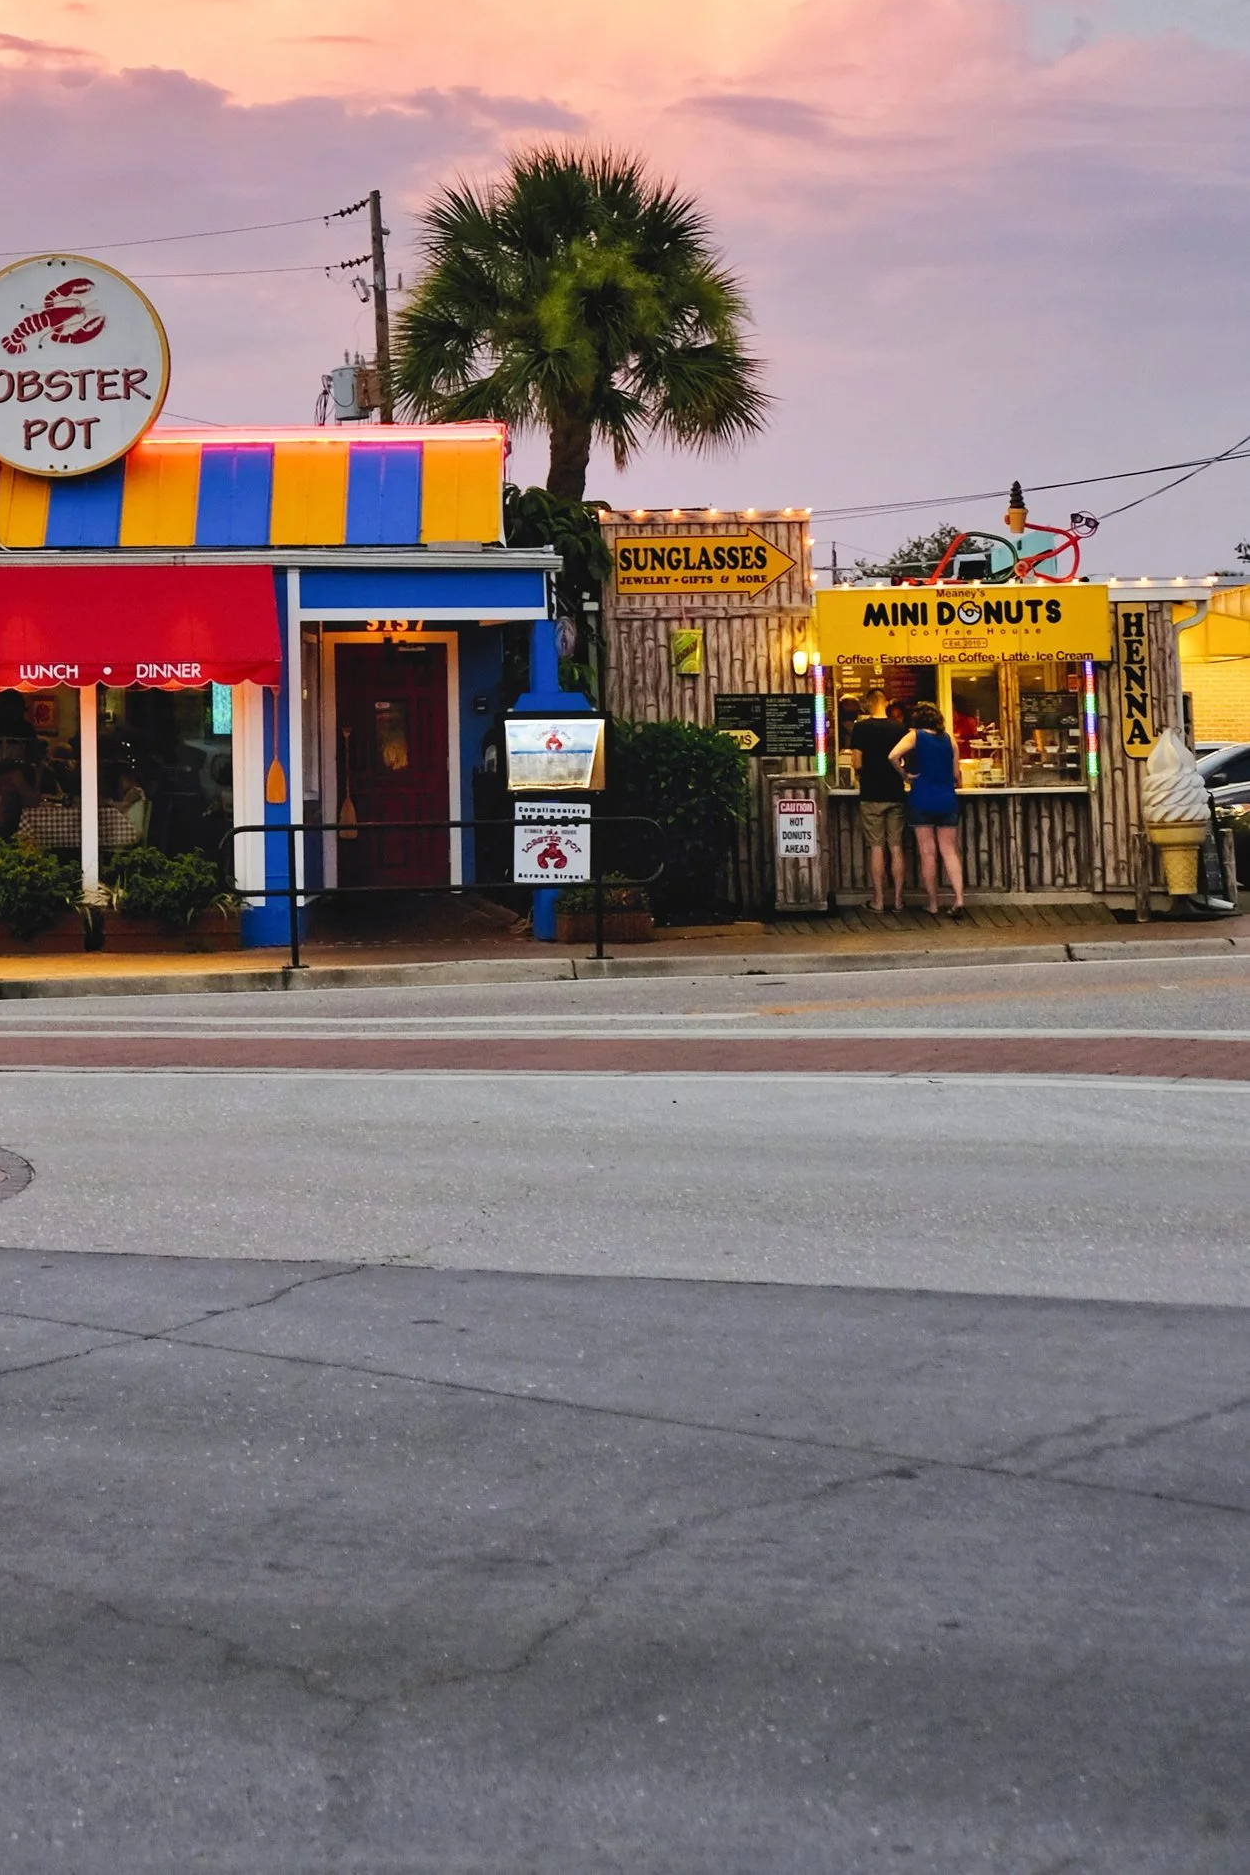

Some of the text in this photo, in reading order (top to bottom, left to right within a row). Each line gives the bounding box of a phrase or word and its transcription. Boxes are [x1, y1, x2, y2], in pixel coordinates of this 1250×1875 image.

[23, 417, 100, 451] POT
[619, 546, 767, 571] SUNGLASSES
[620, 575, 768, 585] JEWELRY GIFTS & MORE
[936, 588, 985, 599] Meaney's
[863, 599, 1062, 627] MINI DONUTS
[910, 628, 972, 636] Coffee
[987, 627, 1041, 635] House
[837, 654, 873, 664] Coffee
[880, 654, 932, 665] Espresso
[939, 653, 955, 663] Ice
[958, 652, 995, 663] Coffee
[1036, 651, 1053, 661] Ice
[1056, 650, 1094, 661] Cream
[20, 664, 79, 679] LUNCH
[136, 663, 202, 679] DINNER
[1122, 613, 1151, 745] HENNA
[518, 806, 586, 815] Complimentary
[780, 803, 813, 812] CAUTION
[789, 817, 804, 826] HOT
[782, 831, 812, 840] DONUTS
[522, 836, 582, 853] LOBSTER POT
[785, 845, 810, 853] AHEAD
